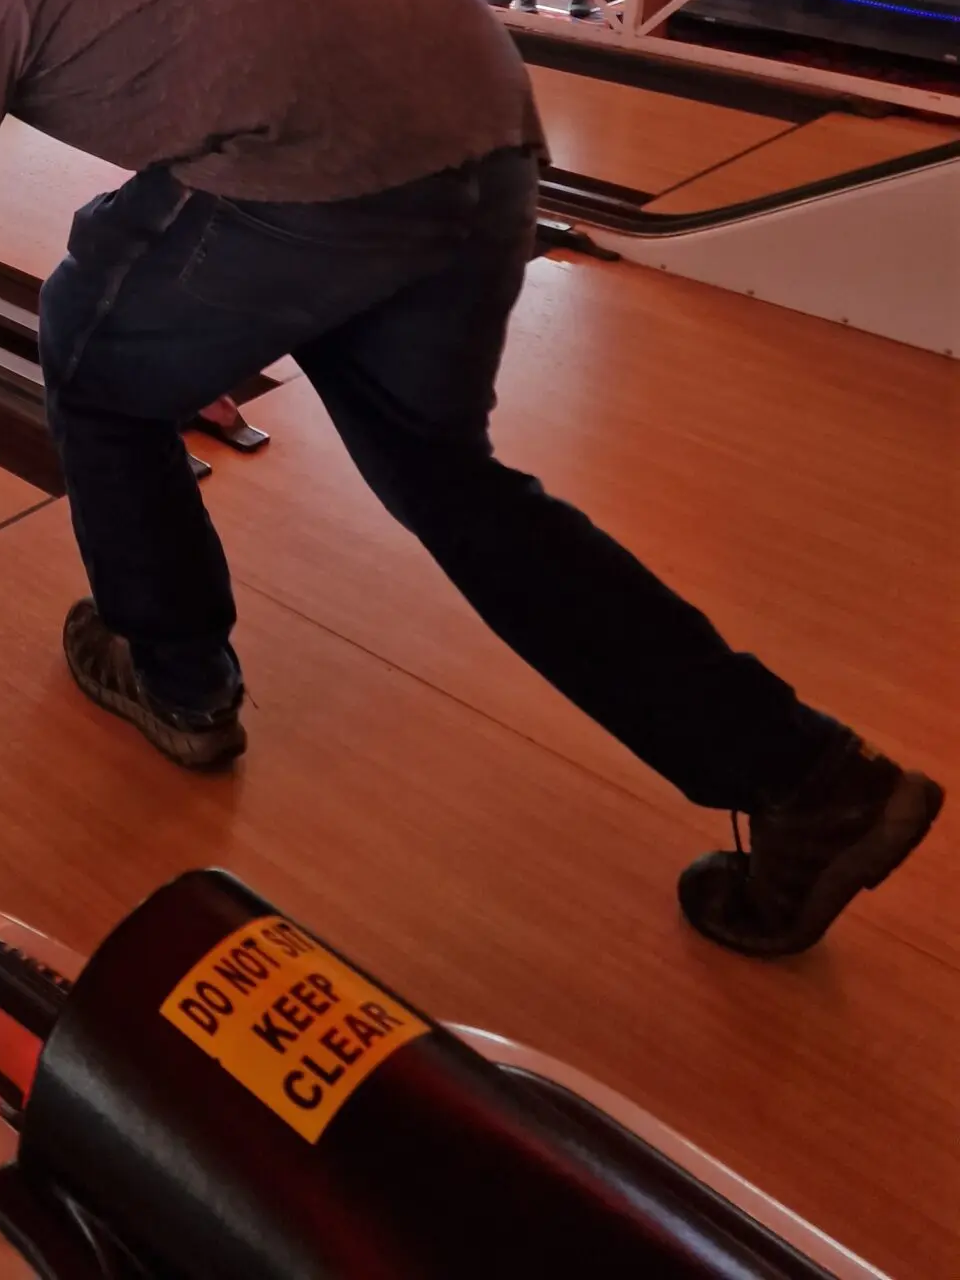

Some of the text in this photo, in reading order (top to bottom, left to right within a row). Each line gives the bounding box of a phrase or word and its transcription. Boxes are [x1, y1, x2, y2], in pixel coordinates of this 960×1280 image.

[178, 980, 234, 1037] DO
[212, 937, 282, 997] NOT
[250, 972, 341, 1055] KEEP
[282, 1000, 405, 1110] CLEAR
